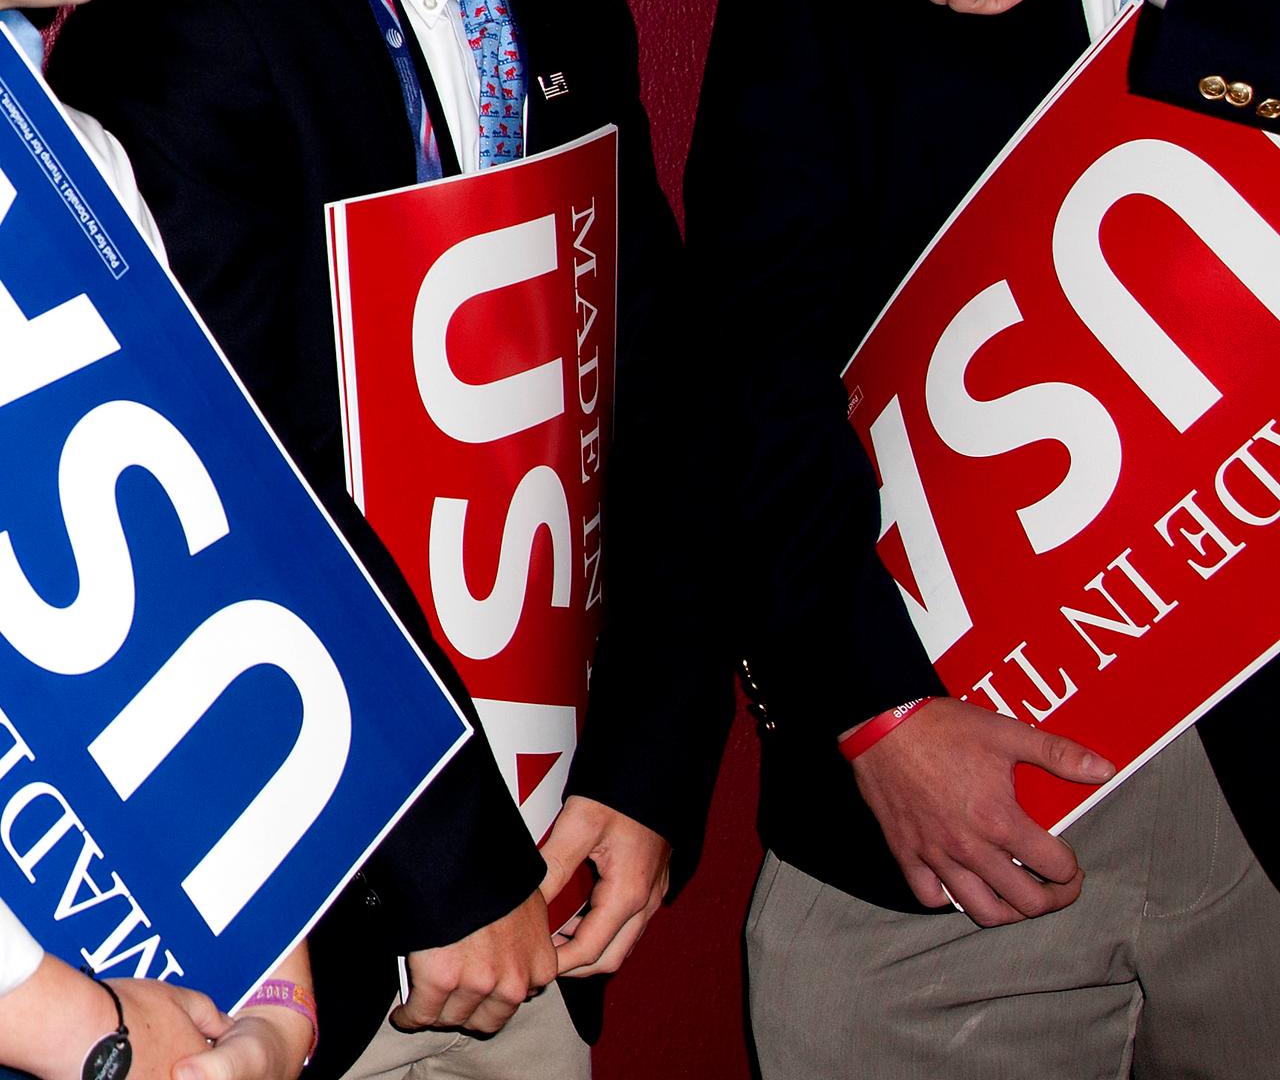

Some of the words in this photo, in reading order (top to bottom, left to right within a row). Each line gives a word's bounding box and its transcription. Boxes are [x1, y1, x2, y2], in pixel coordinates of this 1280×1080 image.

[2, 93, 33, 142] President,
[30, 138, 43, 157] for
[41, 151, 62, 185] Trump
[55, 180, 69, 194] J.
[64, 188, 90, 224] Donald
[86, 220, 98, 235] by
[94, 233, 107, 249] for
[102, 246, 120, 268] Paid
[572, 197, 599, 484] MADE
[875, 139, 1280, 664] USA
[1154, 418, 1280, 580] DE
[412, 214, 576, 846] USA
[582, 502, 603, 612] IN
[1059, 546, 1180, 672] IN
